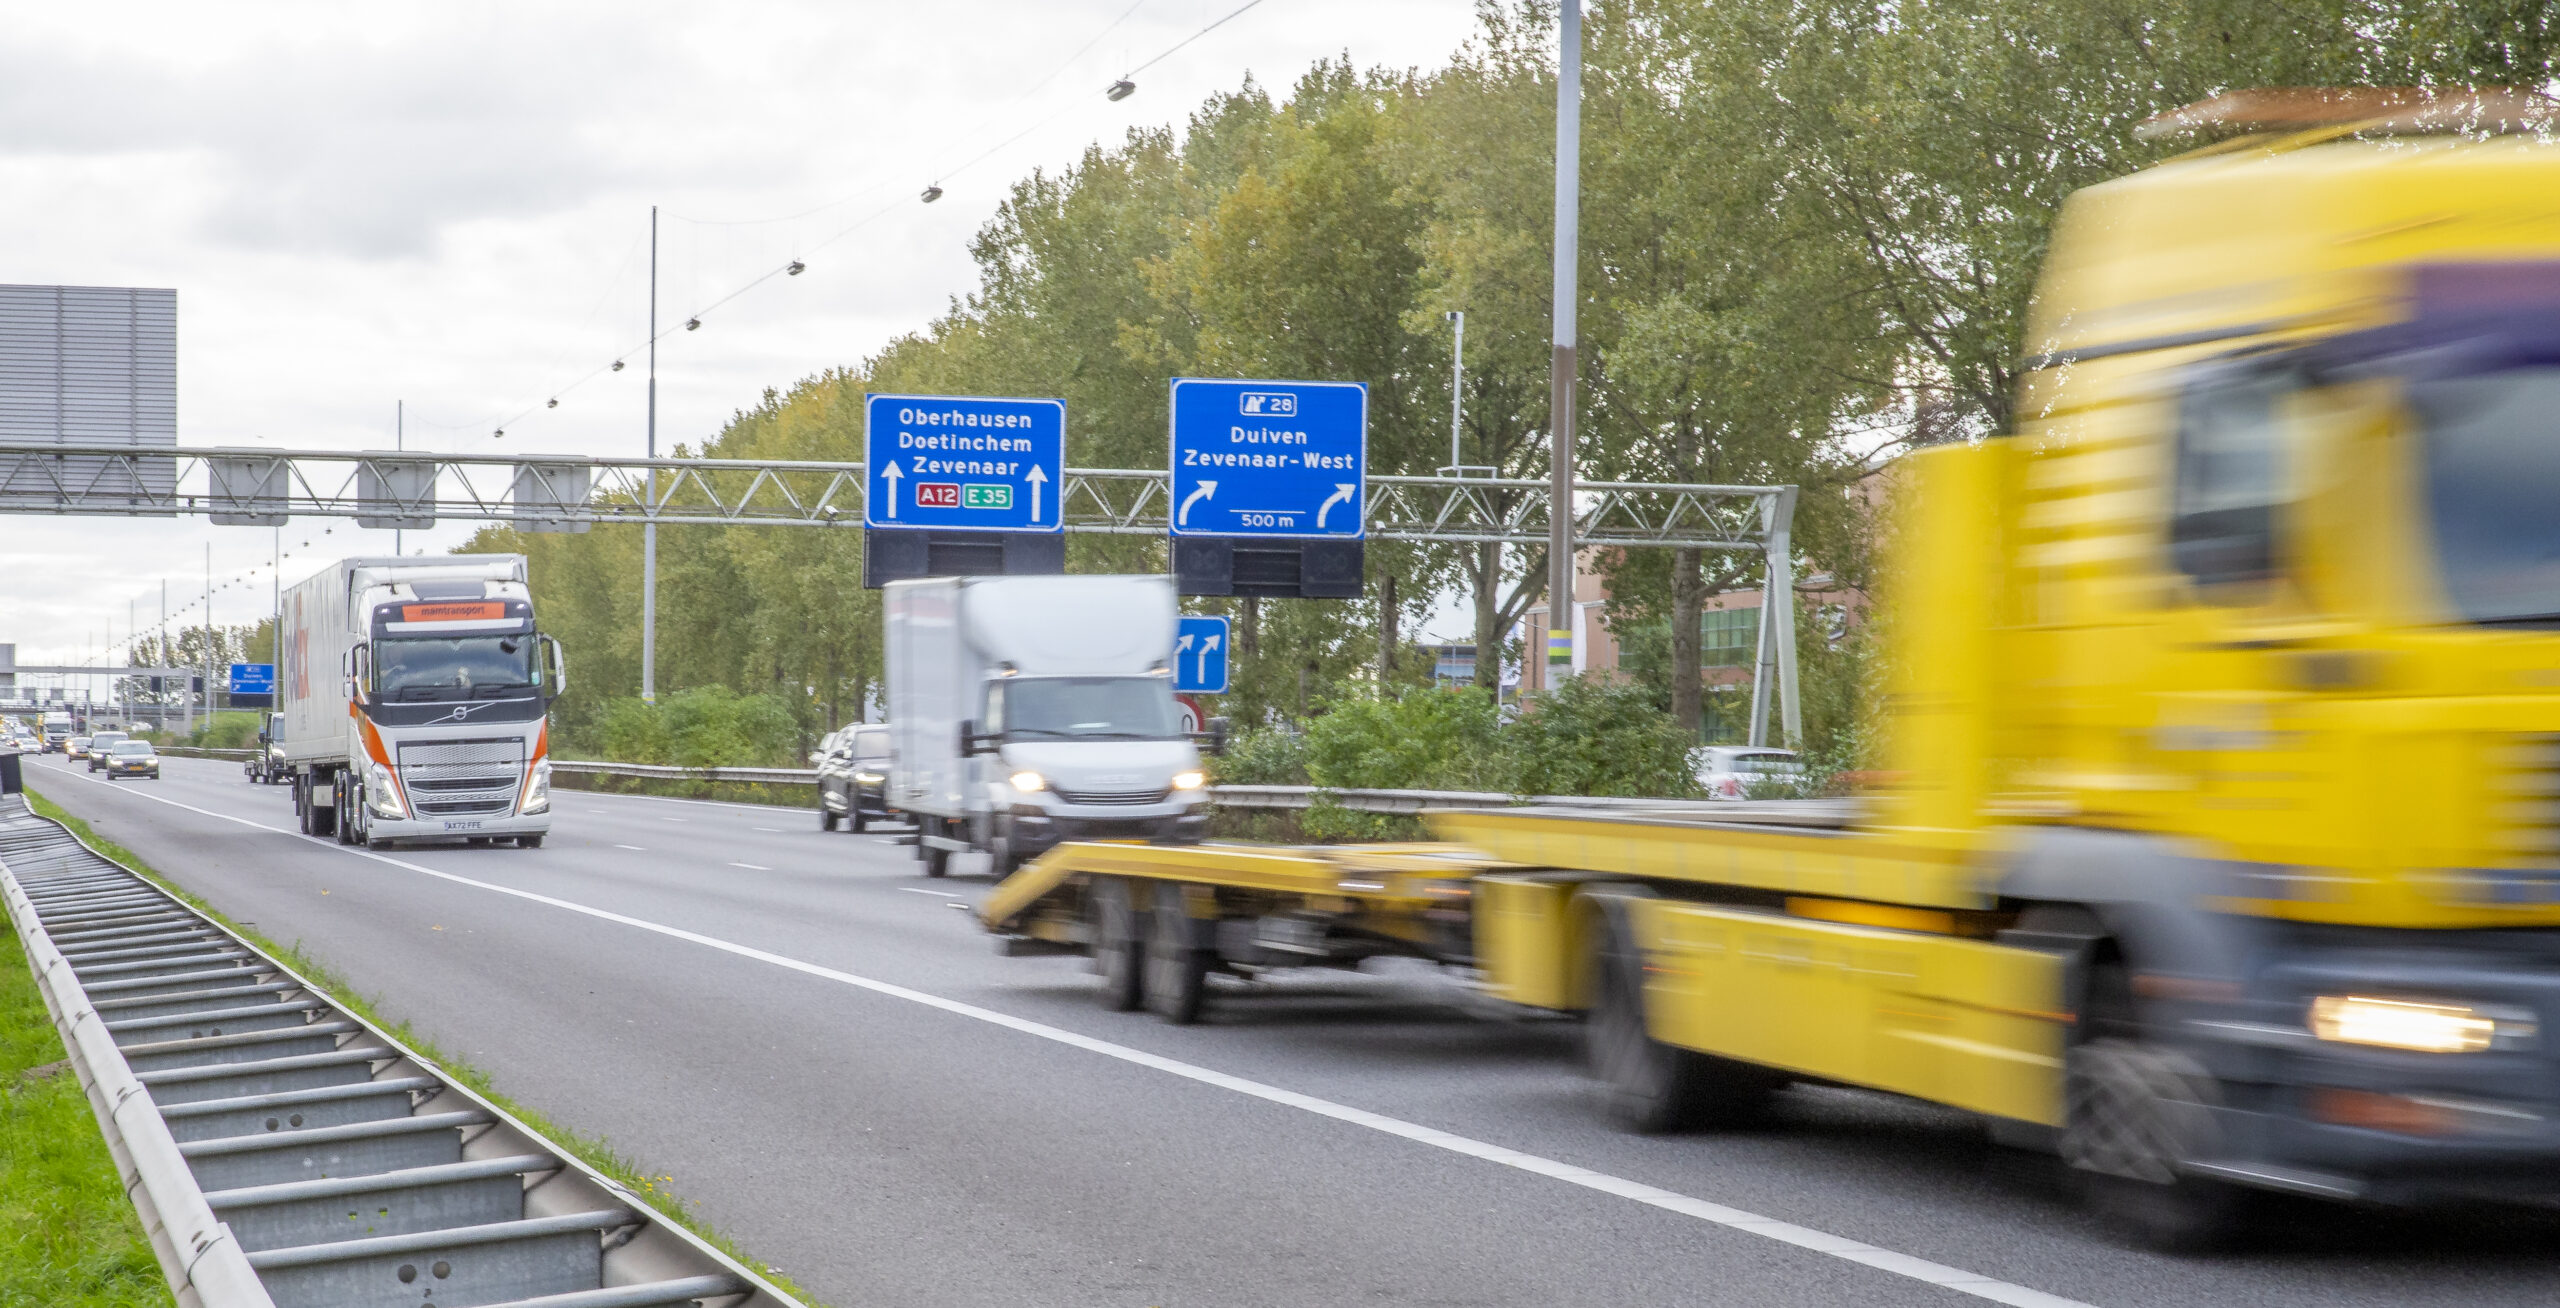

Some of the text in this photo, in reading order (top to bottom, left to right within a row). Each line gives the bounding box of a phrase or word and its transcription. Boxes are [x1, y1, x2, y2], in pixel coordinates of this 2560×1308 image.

[1270, 398, 1293, 412] 28
[899, 407, 1033, 429] Oberhausen
[899, 431, 1033, 453] Doetinchem
[1230, 426, 1307, 445] Duiven
[912, 456, 1020, 476] Zevenaar
[1183, 449, 1355, 470] Zevenaar-West
[920, 488, 957, 504] A12
[968, 489, 1008, 505] E 35
[1241, 514, 1295, 528] 500 m
[421, 606, 485, 617] mamtransport
